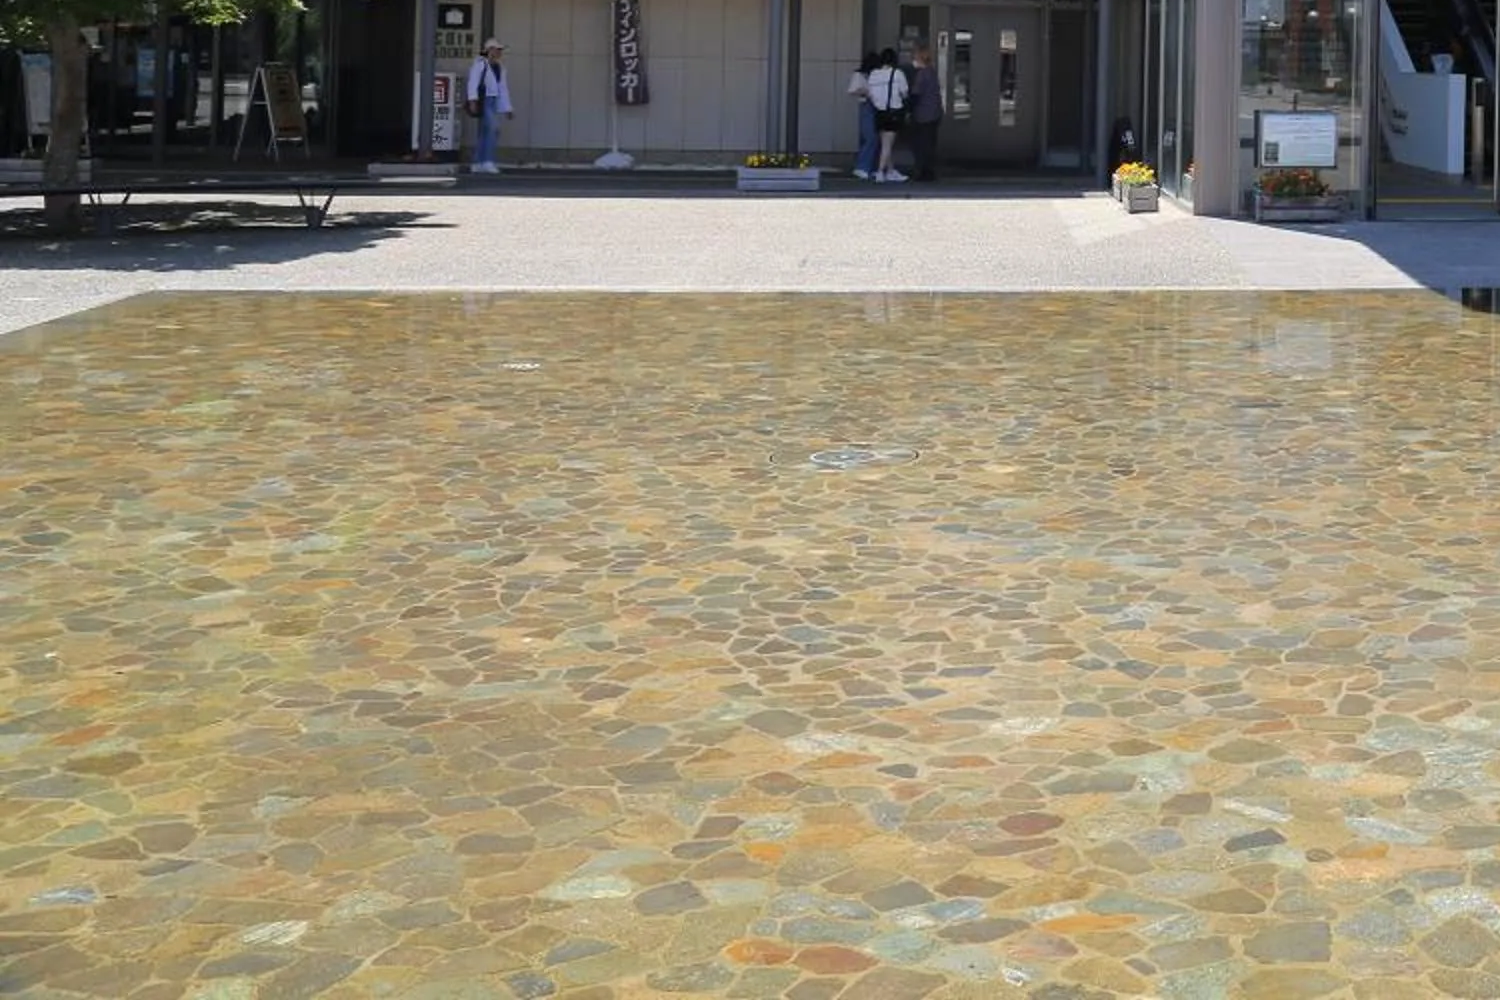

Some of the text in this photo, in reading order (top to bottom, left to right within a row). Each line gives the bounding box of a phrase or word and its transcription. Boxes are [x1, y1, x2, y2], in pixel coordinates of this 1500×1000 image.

[620, 0, 639, 103] コインロッカー
